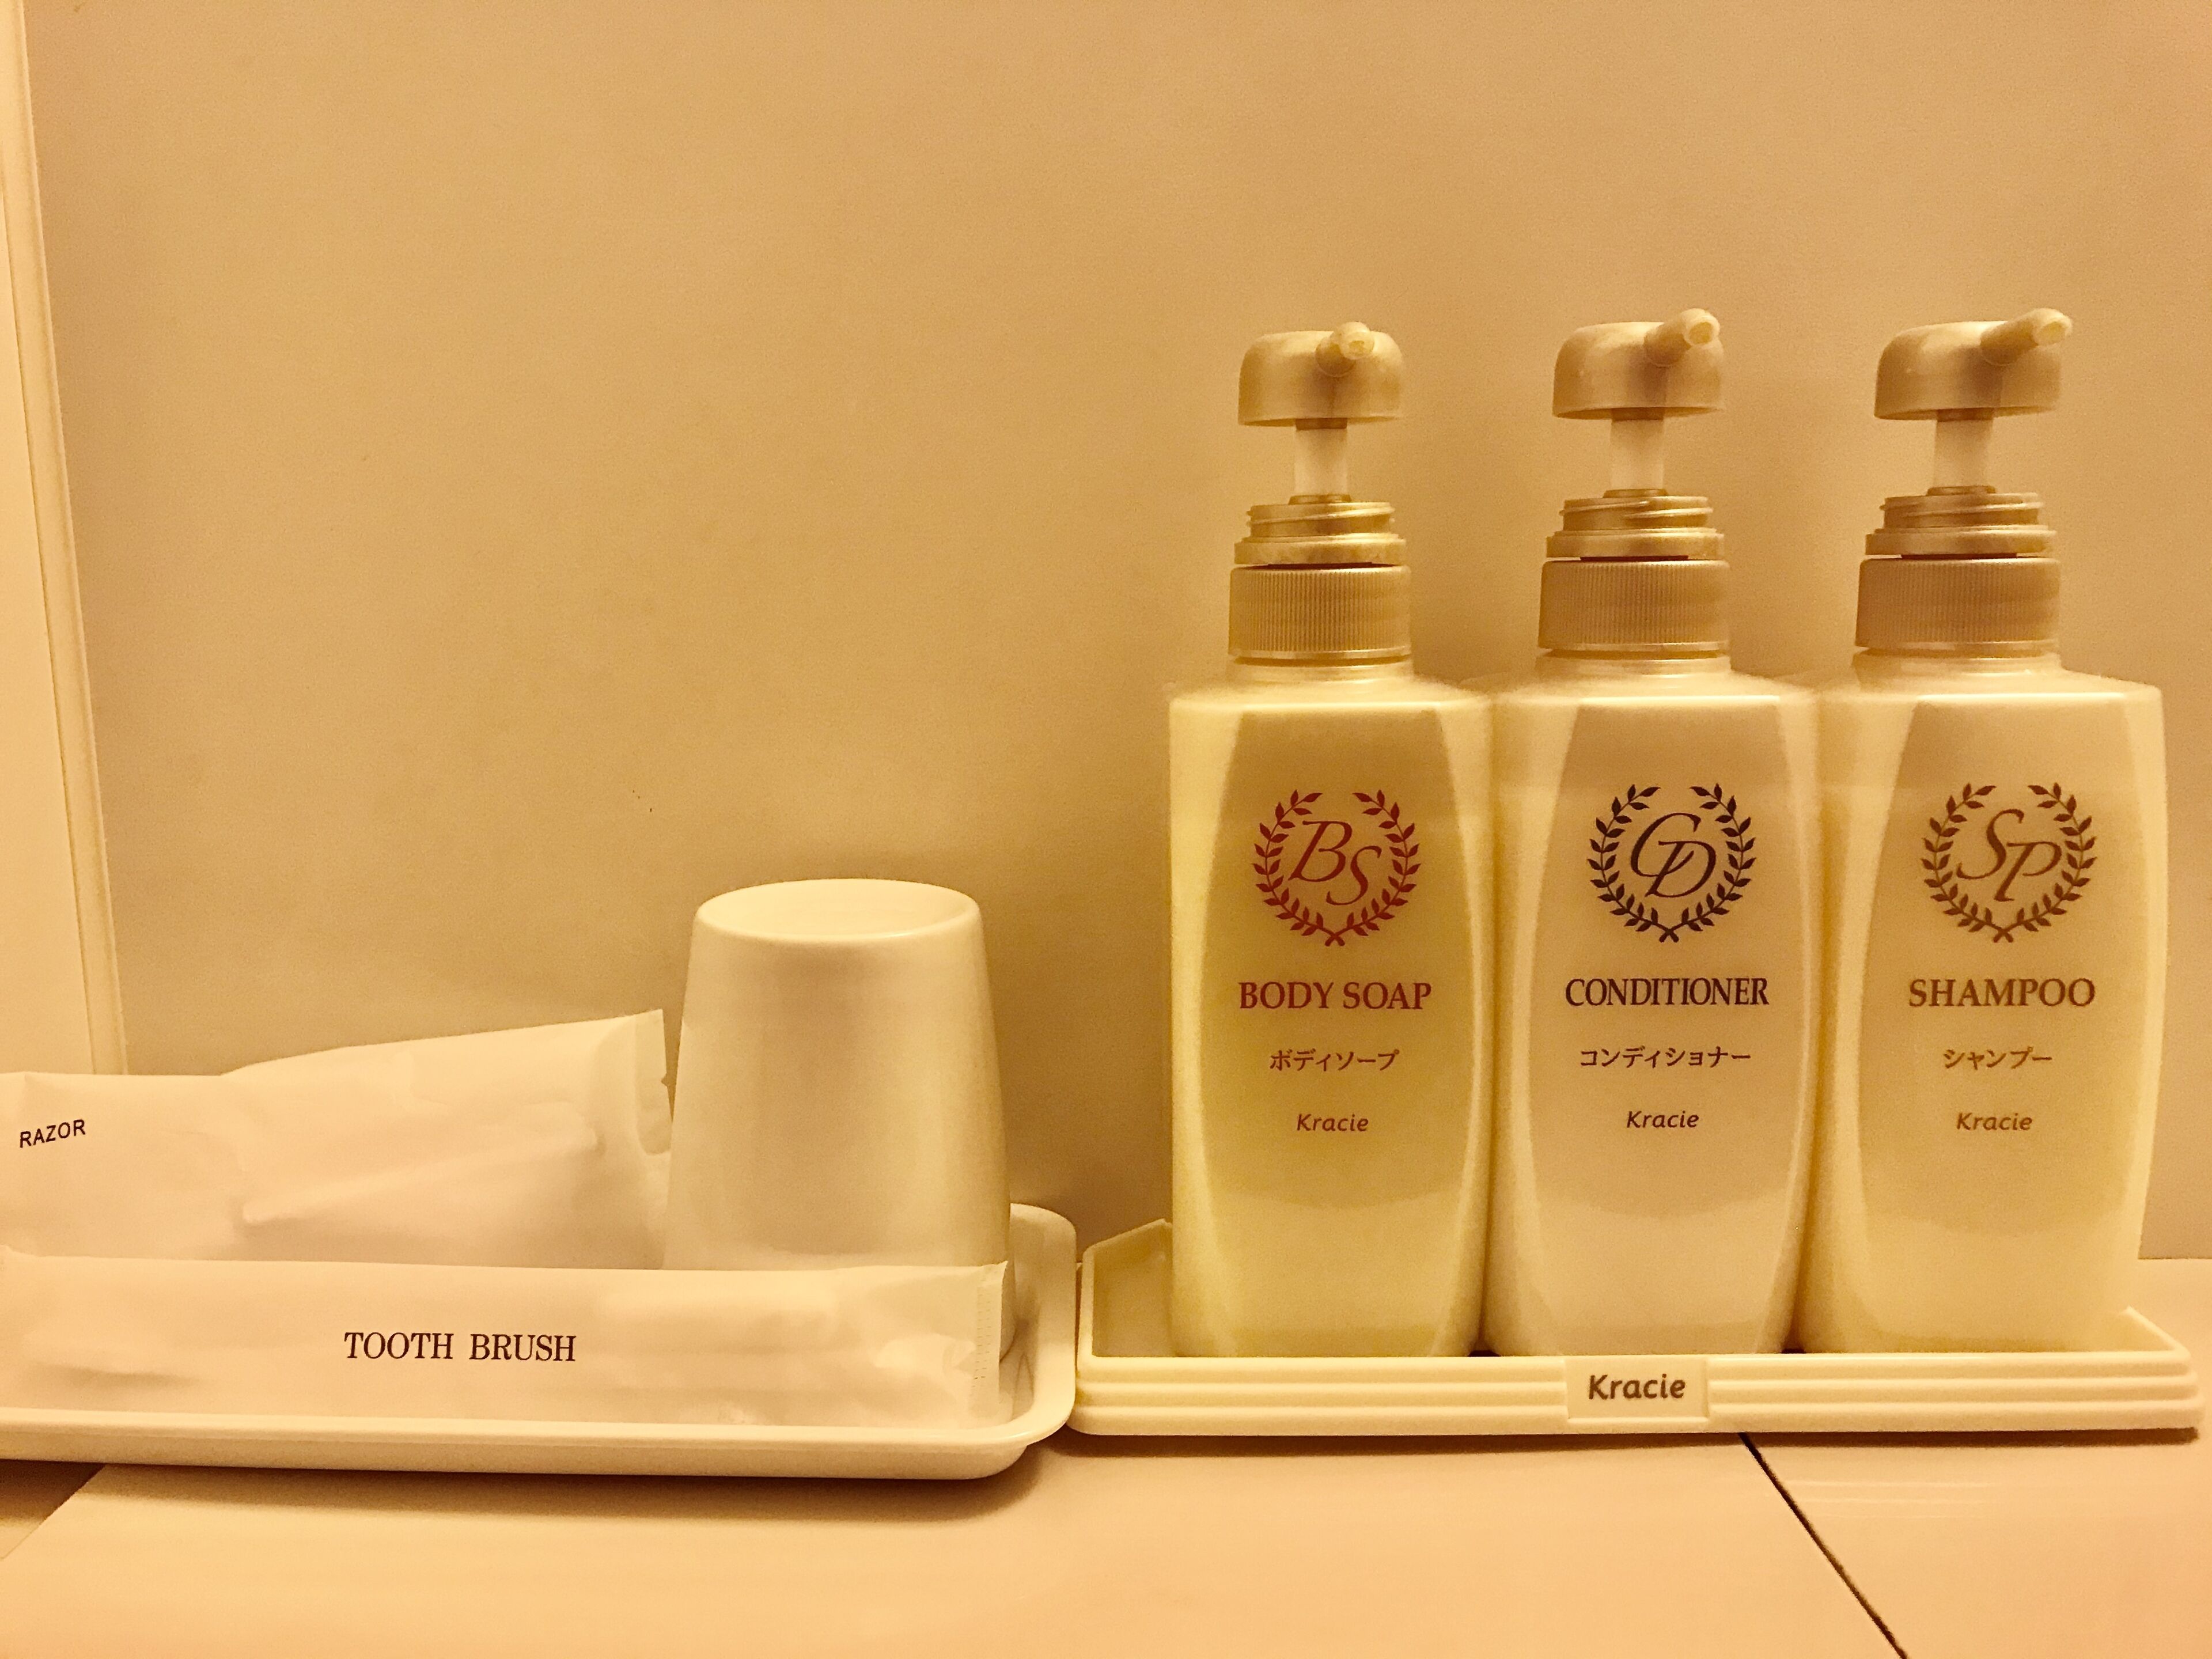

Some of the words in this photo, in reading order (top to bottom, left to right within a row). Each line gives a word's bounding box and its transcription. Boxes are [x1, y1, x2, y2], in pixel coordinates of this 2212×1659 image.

[1288, 820, 1382, 906] BS
[1630, 812, 1717, 897] CD
[1956, 808, 2062, 902] SP
[1238, 981, 1334, 1010] BODY
[1343, 982, 1432, 1010] SOAP
[1565, 978, 1770, 1007] CONDITIONER
[1909, 978, 2096, 1007] SHAMPOO
[1269, 1048, 1400, 1072] ボディソープ
[1580, 1046, 1752, 1069] コンディショナー
[1943, 1047, 2053, 1070] シャンプー
[20, 1119, 86, 1149] RAZOR
[1296, 1113, 1369, 1132] Kracie
[1626, 1110, 1699, 1129] Kracie
[1956, 1112, 2033, 1131] Kracie
[344, 1332, 454, 1360] TOOTH
[469, 1334, 577, 1362] BRUSH
[1588, 1373, 1686, 1400] Kracie
